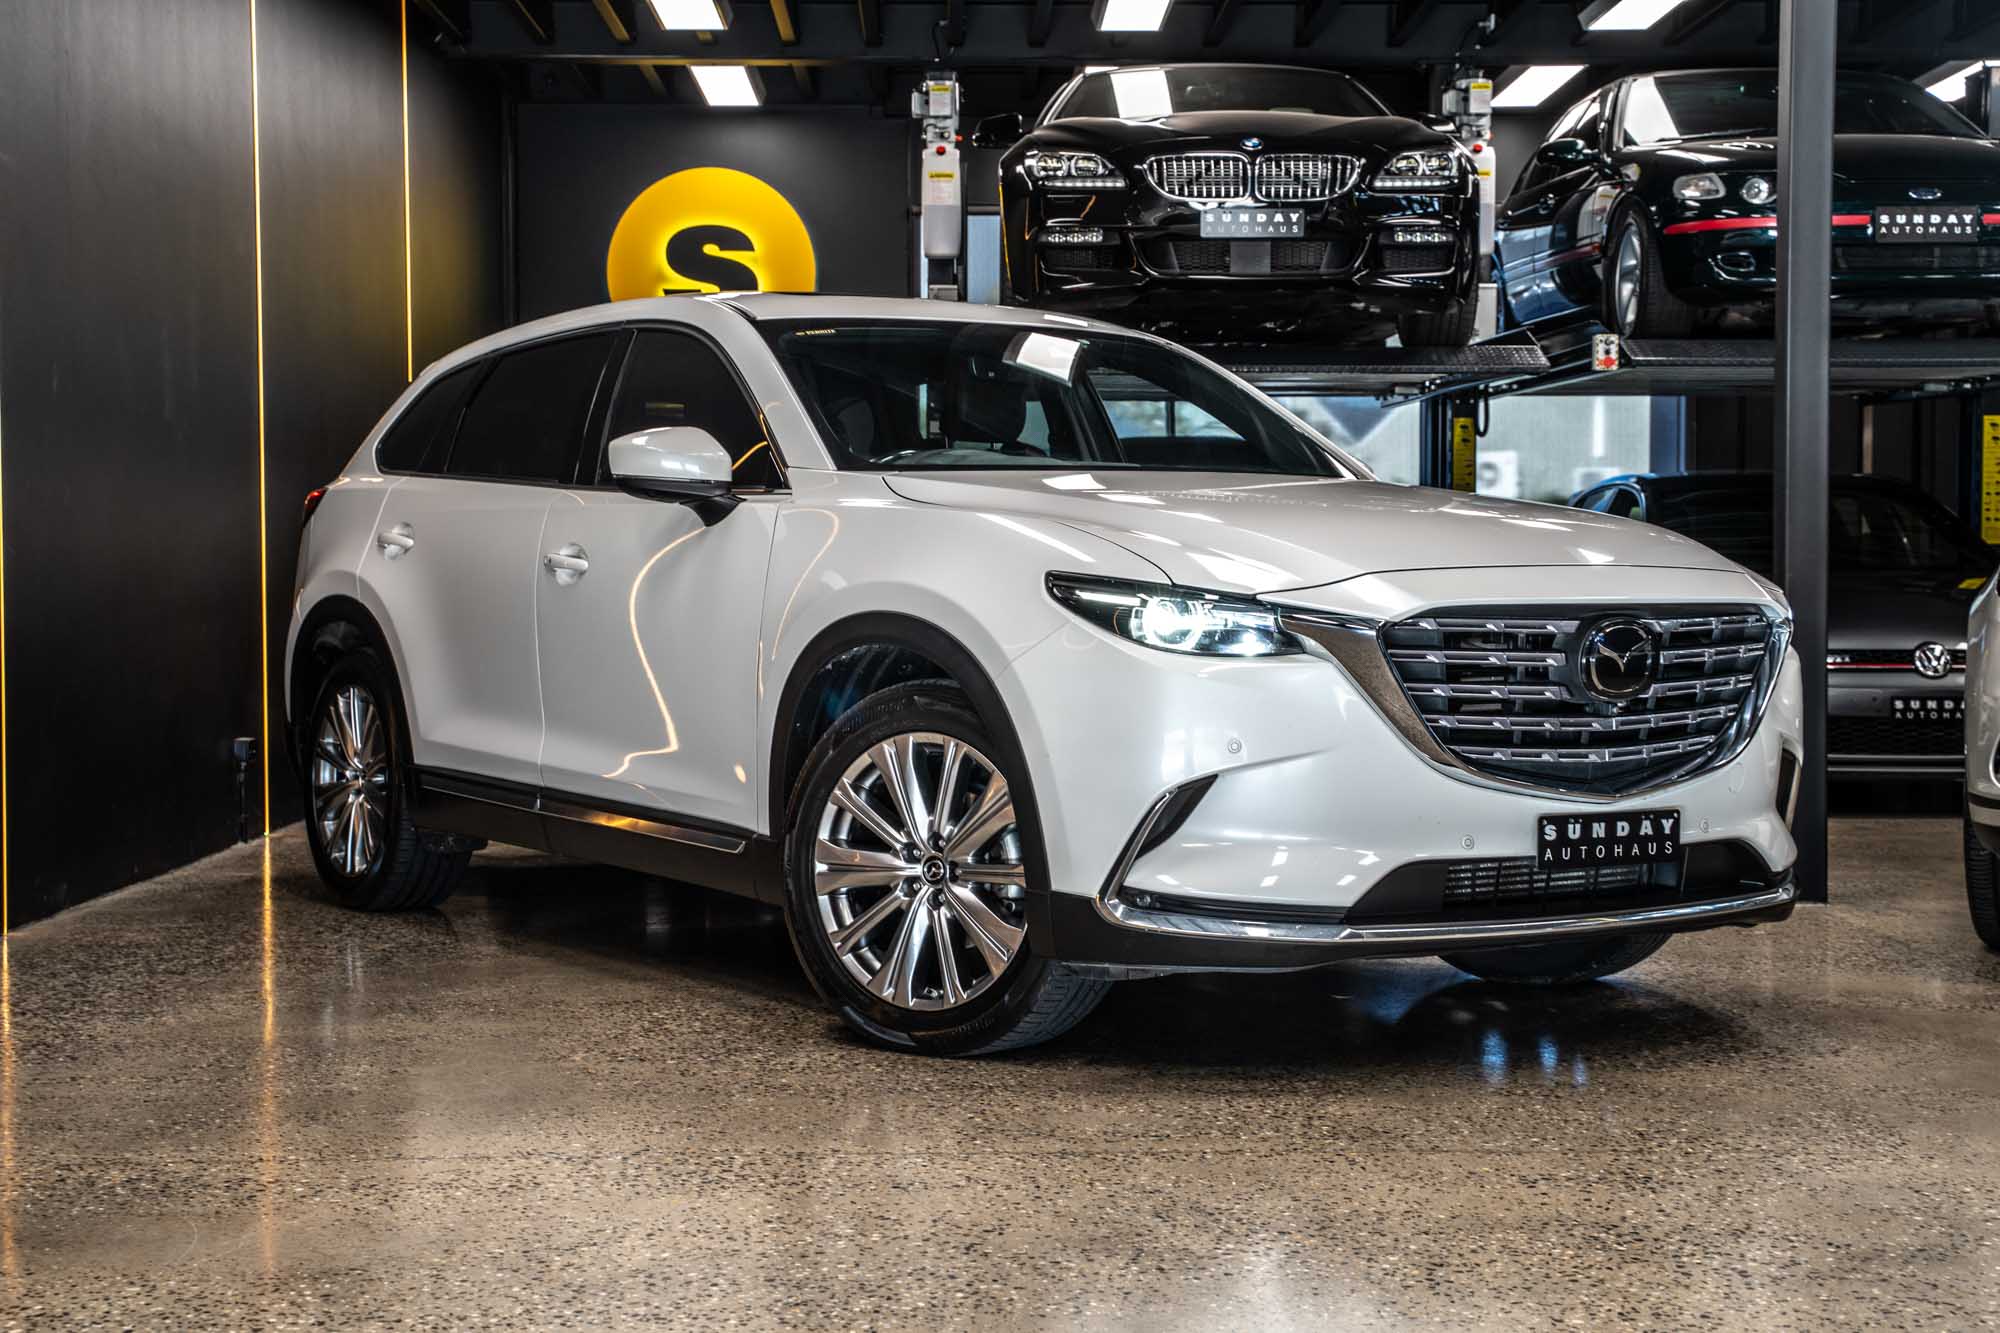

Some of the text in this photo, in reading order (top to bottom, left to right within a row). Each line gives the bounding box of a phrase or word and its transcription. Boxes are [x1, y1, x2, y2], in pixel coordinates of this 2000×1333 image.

[1205, 213, 1300, 223] SUNDAY
[1880, 214, 1974, 224] SUNDAY
[1880, 226, 1973, 234] AUTOHAUS
[663, 225, 758, 296] S
[1543, 818, 1674, 841] SUNDAY
[1544, 841, 1673, 861] AUTOHAUS
